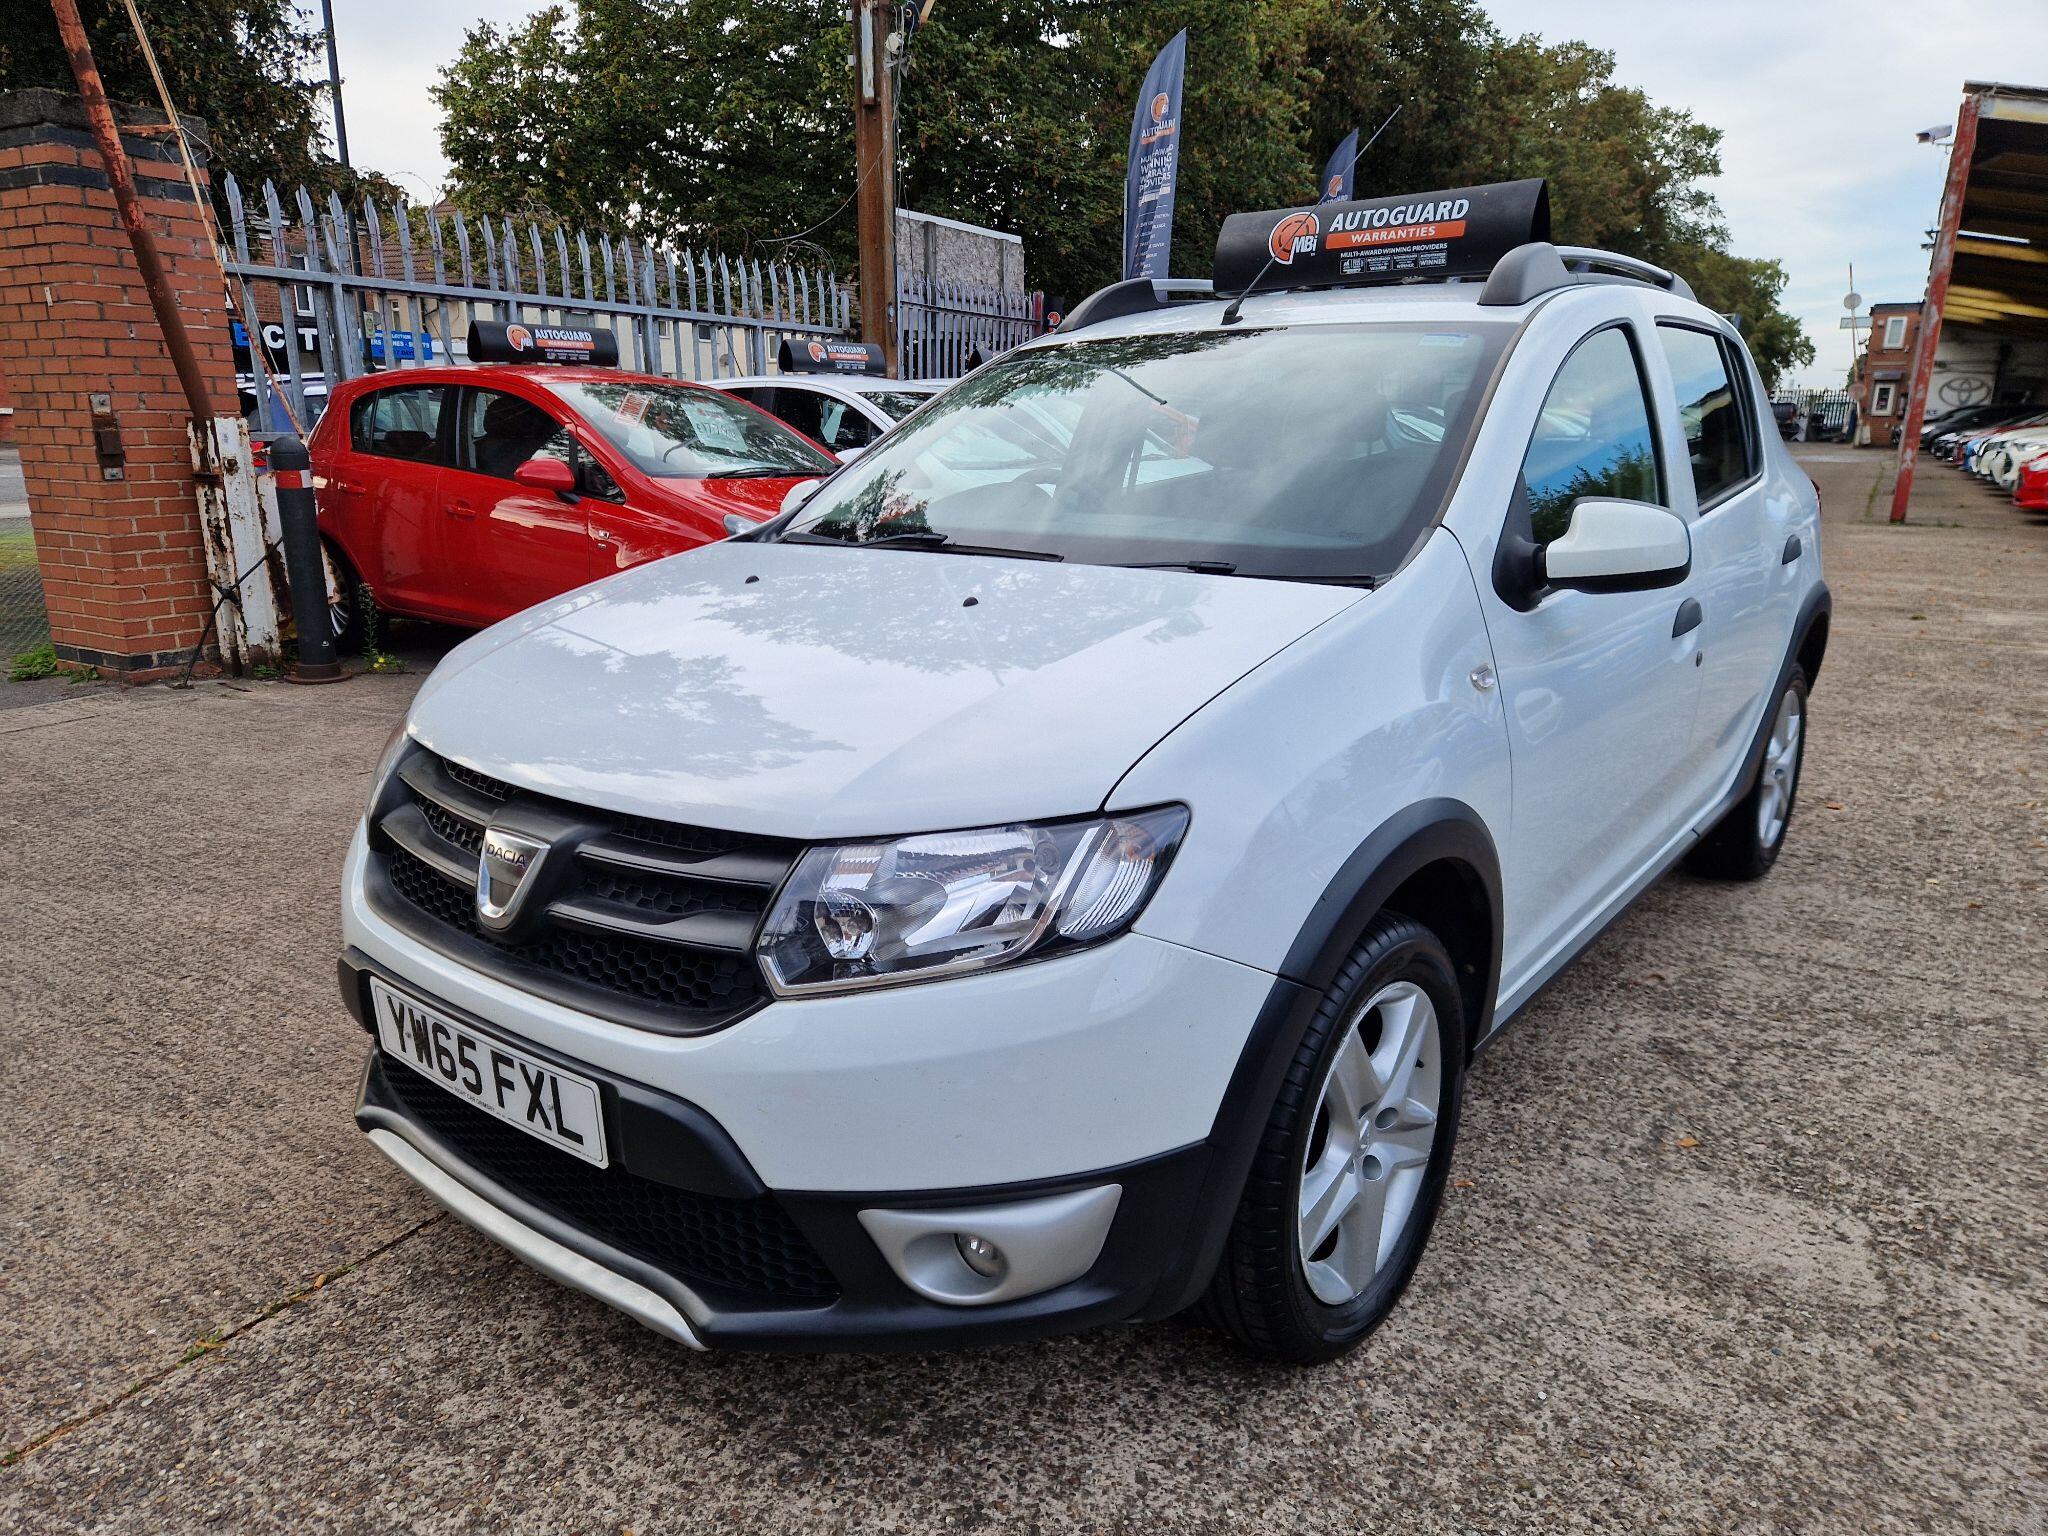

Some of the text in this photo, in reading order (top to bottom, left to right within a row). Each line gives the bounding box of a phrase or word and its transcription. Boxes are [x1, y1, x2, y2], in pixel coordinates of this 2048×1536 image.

[1328, 199, 1470, 232] AUTOGUARD
[1351, 225, 1436, 244] WARRANTIES
[1340, 242, 1448, 259] MULTI-AWARD WINNING PROVIDERS
[534, 329, 592, 342] AUTOGUARD
[827, 345, 867, 354] AUTOGUARD
[486, 843, 526, 867] DACIA
[387, 995, 585, 1146] YW65 FXL
